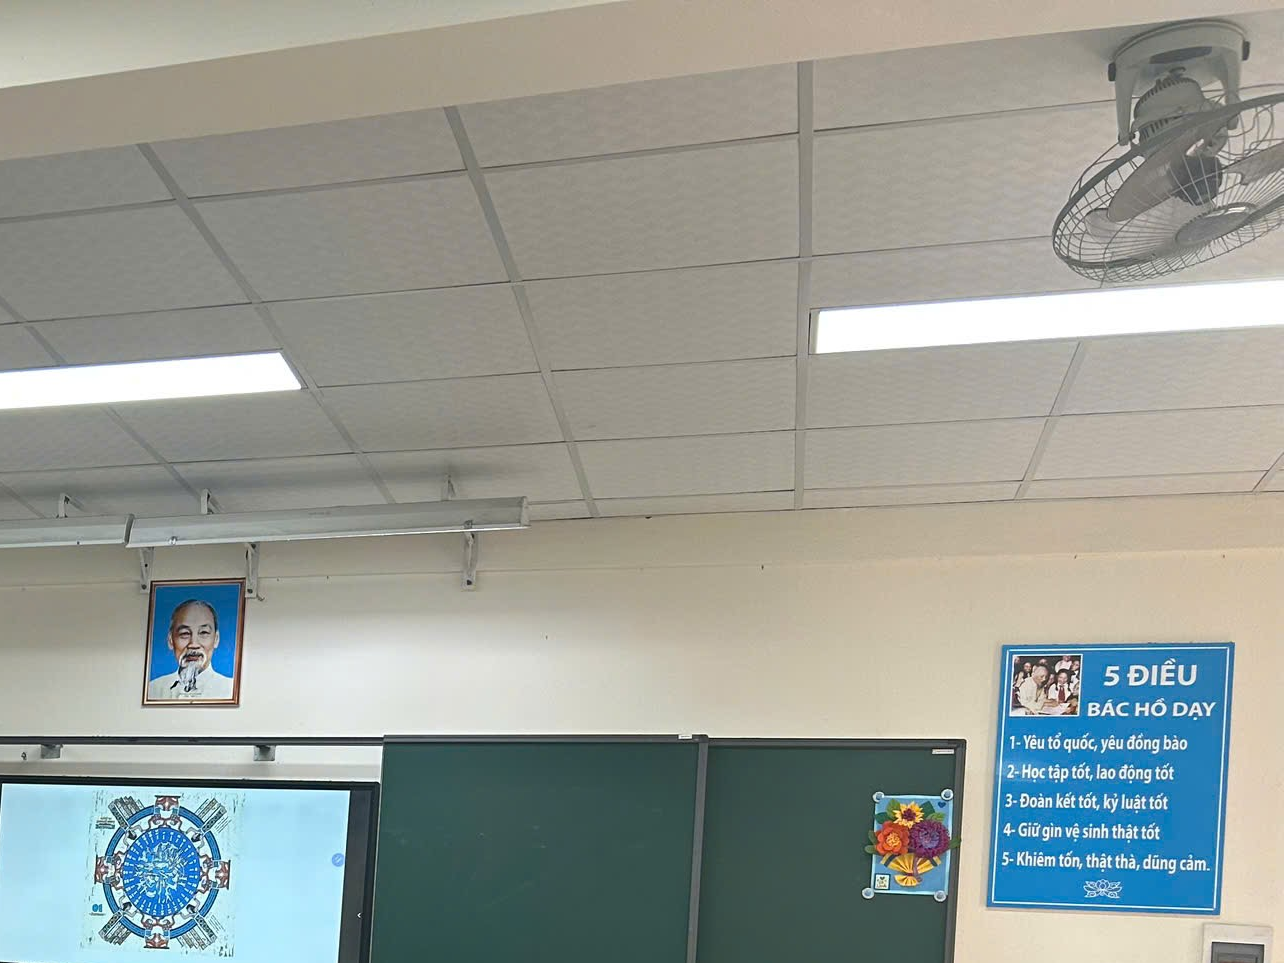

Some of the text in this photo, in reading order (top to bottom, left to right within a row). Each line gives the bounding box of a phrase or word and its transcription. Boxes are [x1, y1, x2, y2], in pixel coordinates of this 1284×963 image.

[1103, 657, 1197, 686] 5 ĐIỀU
[1087, 697, 1216, 721] BÁC HỒ DẠY
[1023, 734, 1045, 750] Yêu
[1047, 732, 1062, 750] tổ
[1063, 732, 1098, 753] quốc,
[1101, 734, 1124, 754] yêu
[1126, 732, 1160, 754] đồng
[1163, 734, 1188, 751] bào
[1022, 763, 1046, 783] Học
[1048, 763, 1069, 783] tập
[1071, 762, 1093, 781] tốt,
[1096, 763, 1116, 780] lao
[1118, 764, 1152, 784] động
[1155, 762, 1174, 780] tốt
[1019, 793, 1053, 808] Đoàn
[1056, 791, 1076, 808] kết
[1078, 791, 1100, 811] tốt,
[1103, 793, 1119, 814] kỷ
[1121, 793, 1146, 814] luật
[1149, 792, 1168, 810] tốt
[1018, 822, 1041, 837] Giữ
[1042, 822, 1062, 841] gìn
[1065, 823, 1080, 842] vệ
[1082, 823, 1109, 839] sinh
[1111, 823, 1139, 843] thật
[1141, 822, 1160, 840] tốt
[1016, 851, 1056, 867] Khiêm
[1059, 850, 1083, 870] tốn,
[1086, 852, 1113, 872] thật
[1115, 853, 1140, 871] thà,
[1143, 854, 1177, 874] dũng
[1179, 854, 1211, 872] cảm.
